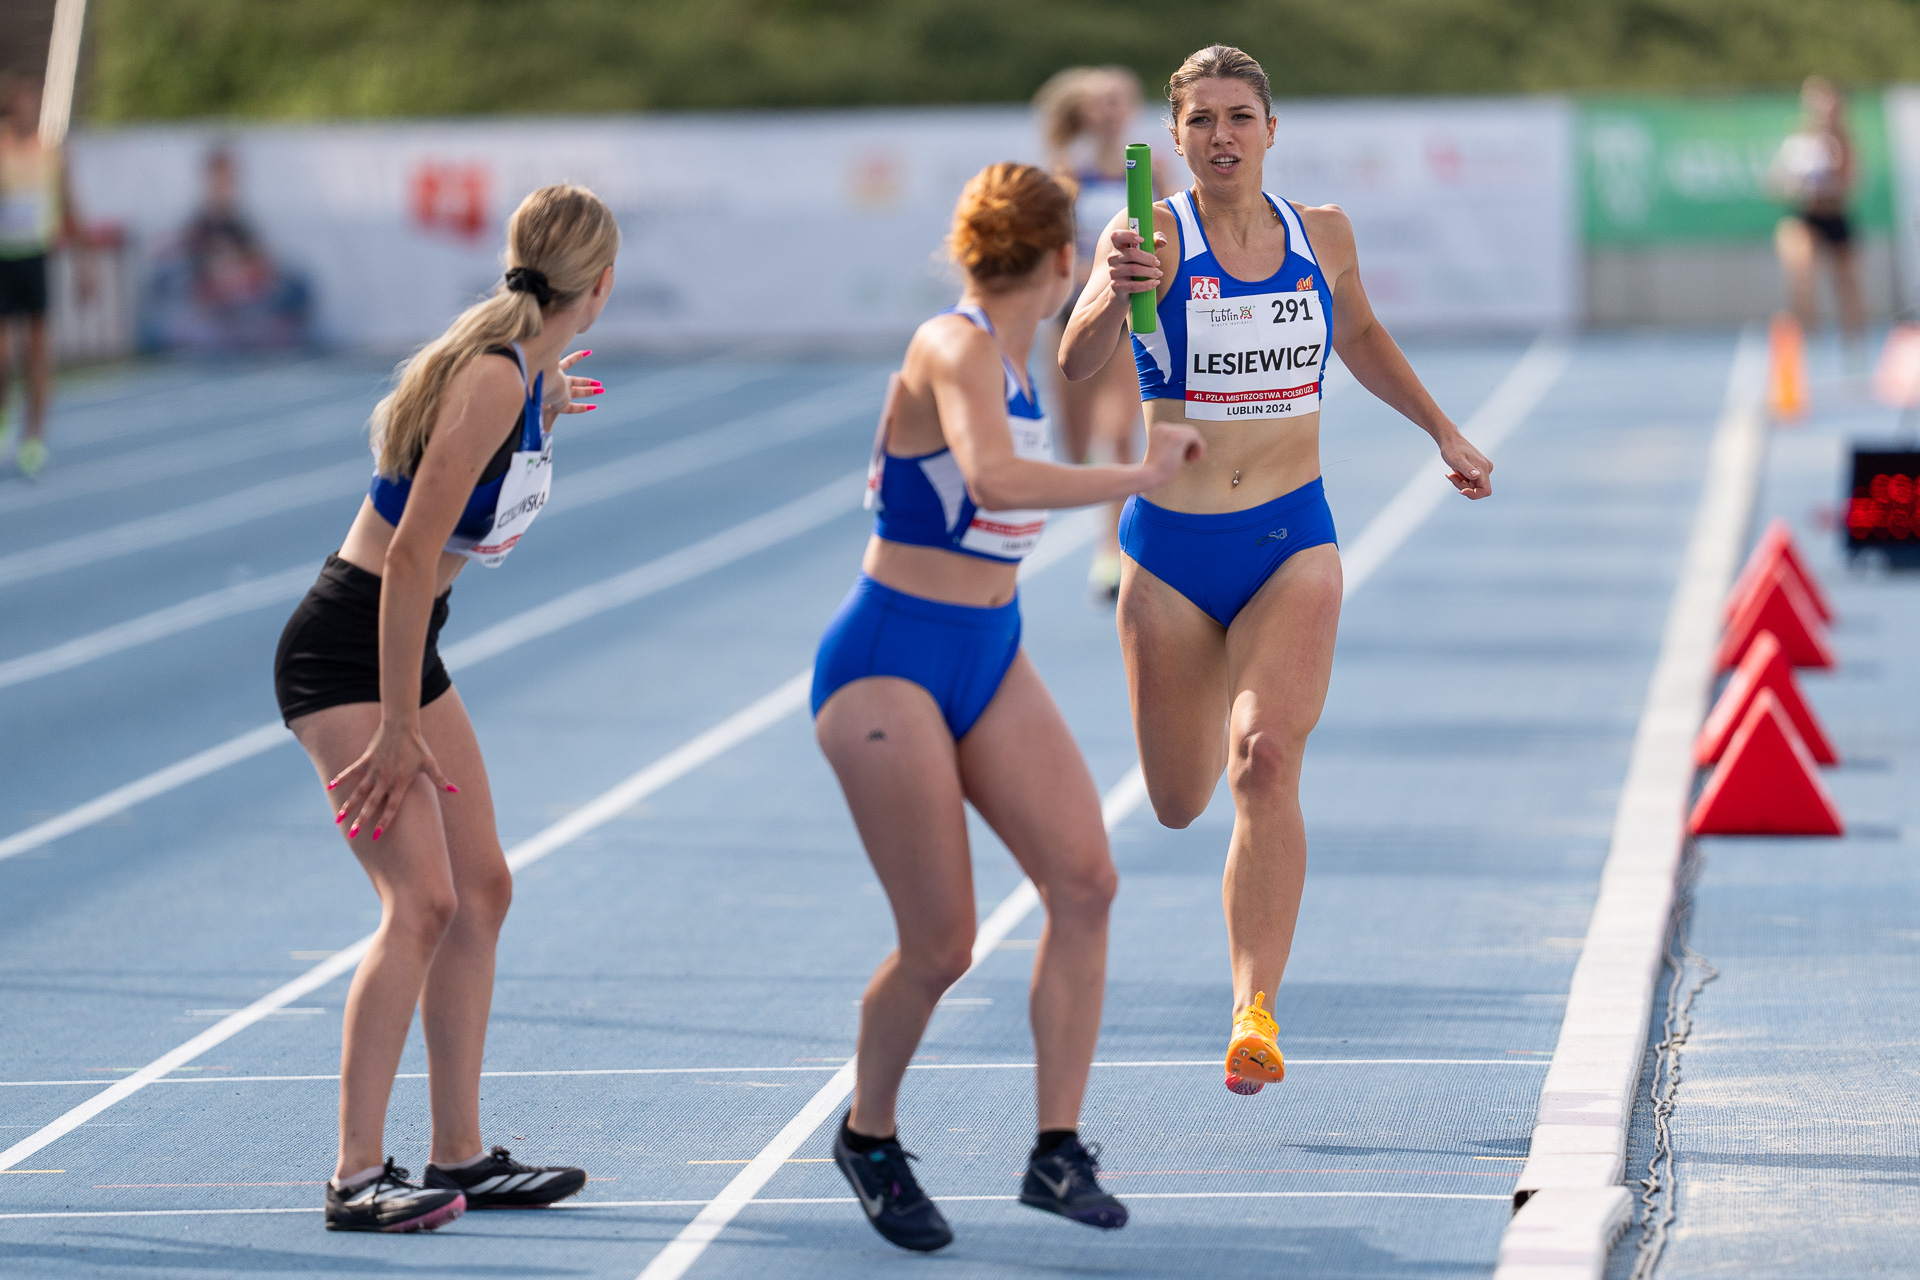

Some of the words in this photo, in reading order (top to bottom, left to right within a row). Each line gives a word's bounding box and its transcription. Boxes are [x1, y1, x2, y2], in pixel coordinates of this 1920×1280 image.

[1271, 298, 1314, 324] 291
[1193, 344, 1321, 375] LESIEWICZ
[1194, 393, 1204, 401] 41.
[1205, 394, 1225, 402] PZLA
[1226, 391, 1281, 402] MISTRZOSTWA
[1282, 388, 1304, 398] POLSKI
[1304, 385, 1314, 394] U23
[1227, 404, 1263, 415] LUBLIN
[1265, 403, 1292, 414] 2024
